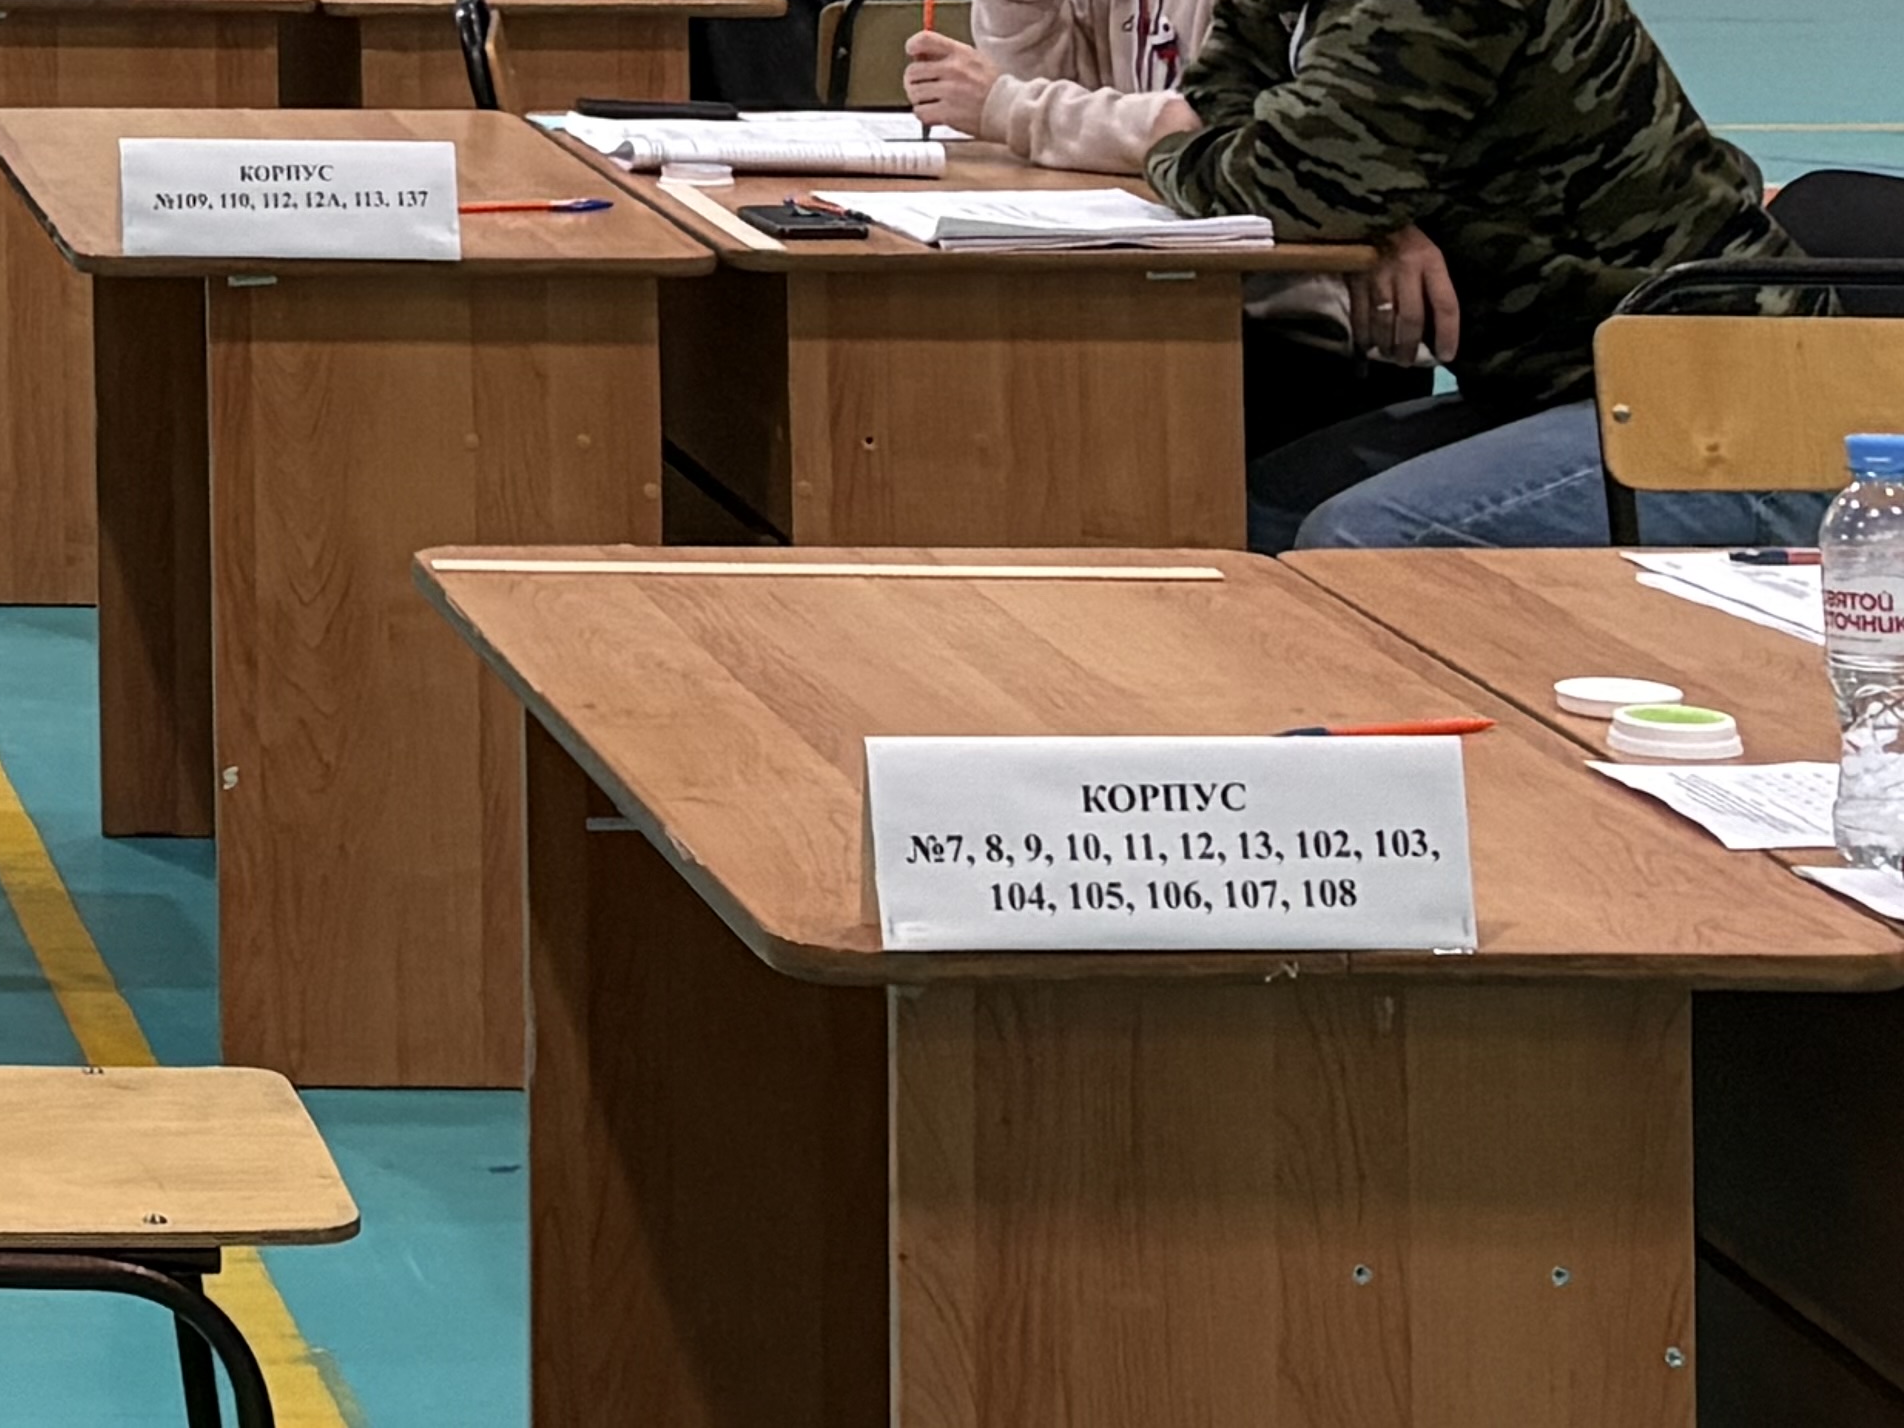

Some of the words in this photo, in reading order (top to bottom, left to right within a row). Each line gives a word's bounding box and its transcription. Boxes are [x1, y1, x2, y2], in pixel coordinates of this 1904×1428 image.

[239, 164, 334, 183] КОРПУС
[220, 192, 256, 211] 110,
[262, 191, 298, 210] 112,
[398, 190, 429, 208] 137
[1081, 782, 1246, 813] КОРПУС
[906, 834, 976, 866] №7,
[985, 833, 1015, 866] 8,
[1024, 833, 1054, 866] 9,
[1067, 833, 1112, 865] 10,
[1124, 832, 1168, 865] 11,
[1181, 831, 1227, 863] 12,
[1238, 830, 1285, 862] 13,
[1297, 829, 1363, 861] 102,
[1375, 828, 1441, 862] 103,
[991, 882, 1057, 913] 104,
[1069, 881, 1135, 913] 105,
[1147, 880, 1213, 914] 106,
[1225, 879, 1290, 912] 107,
[1303, 879, 1358, 908] 108
